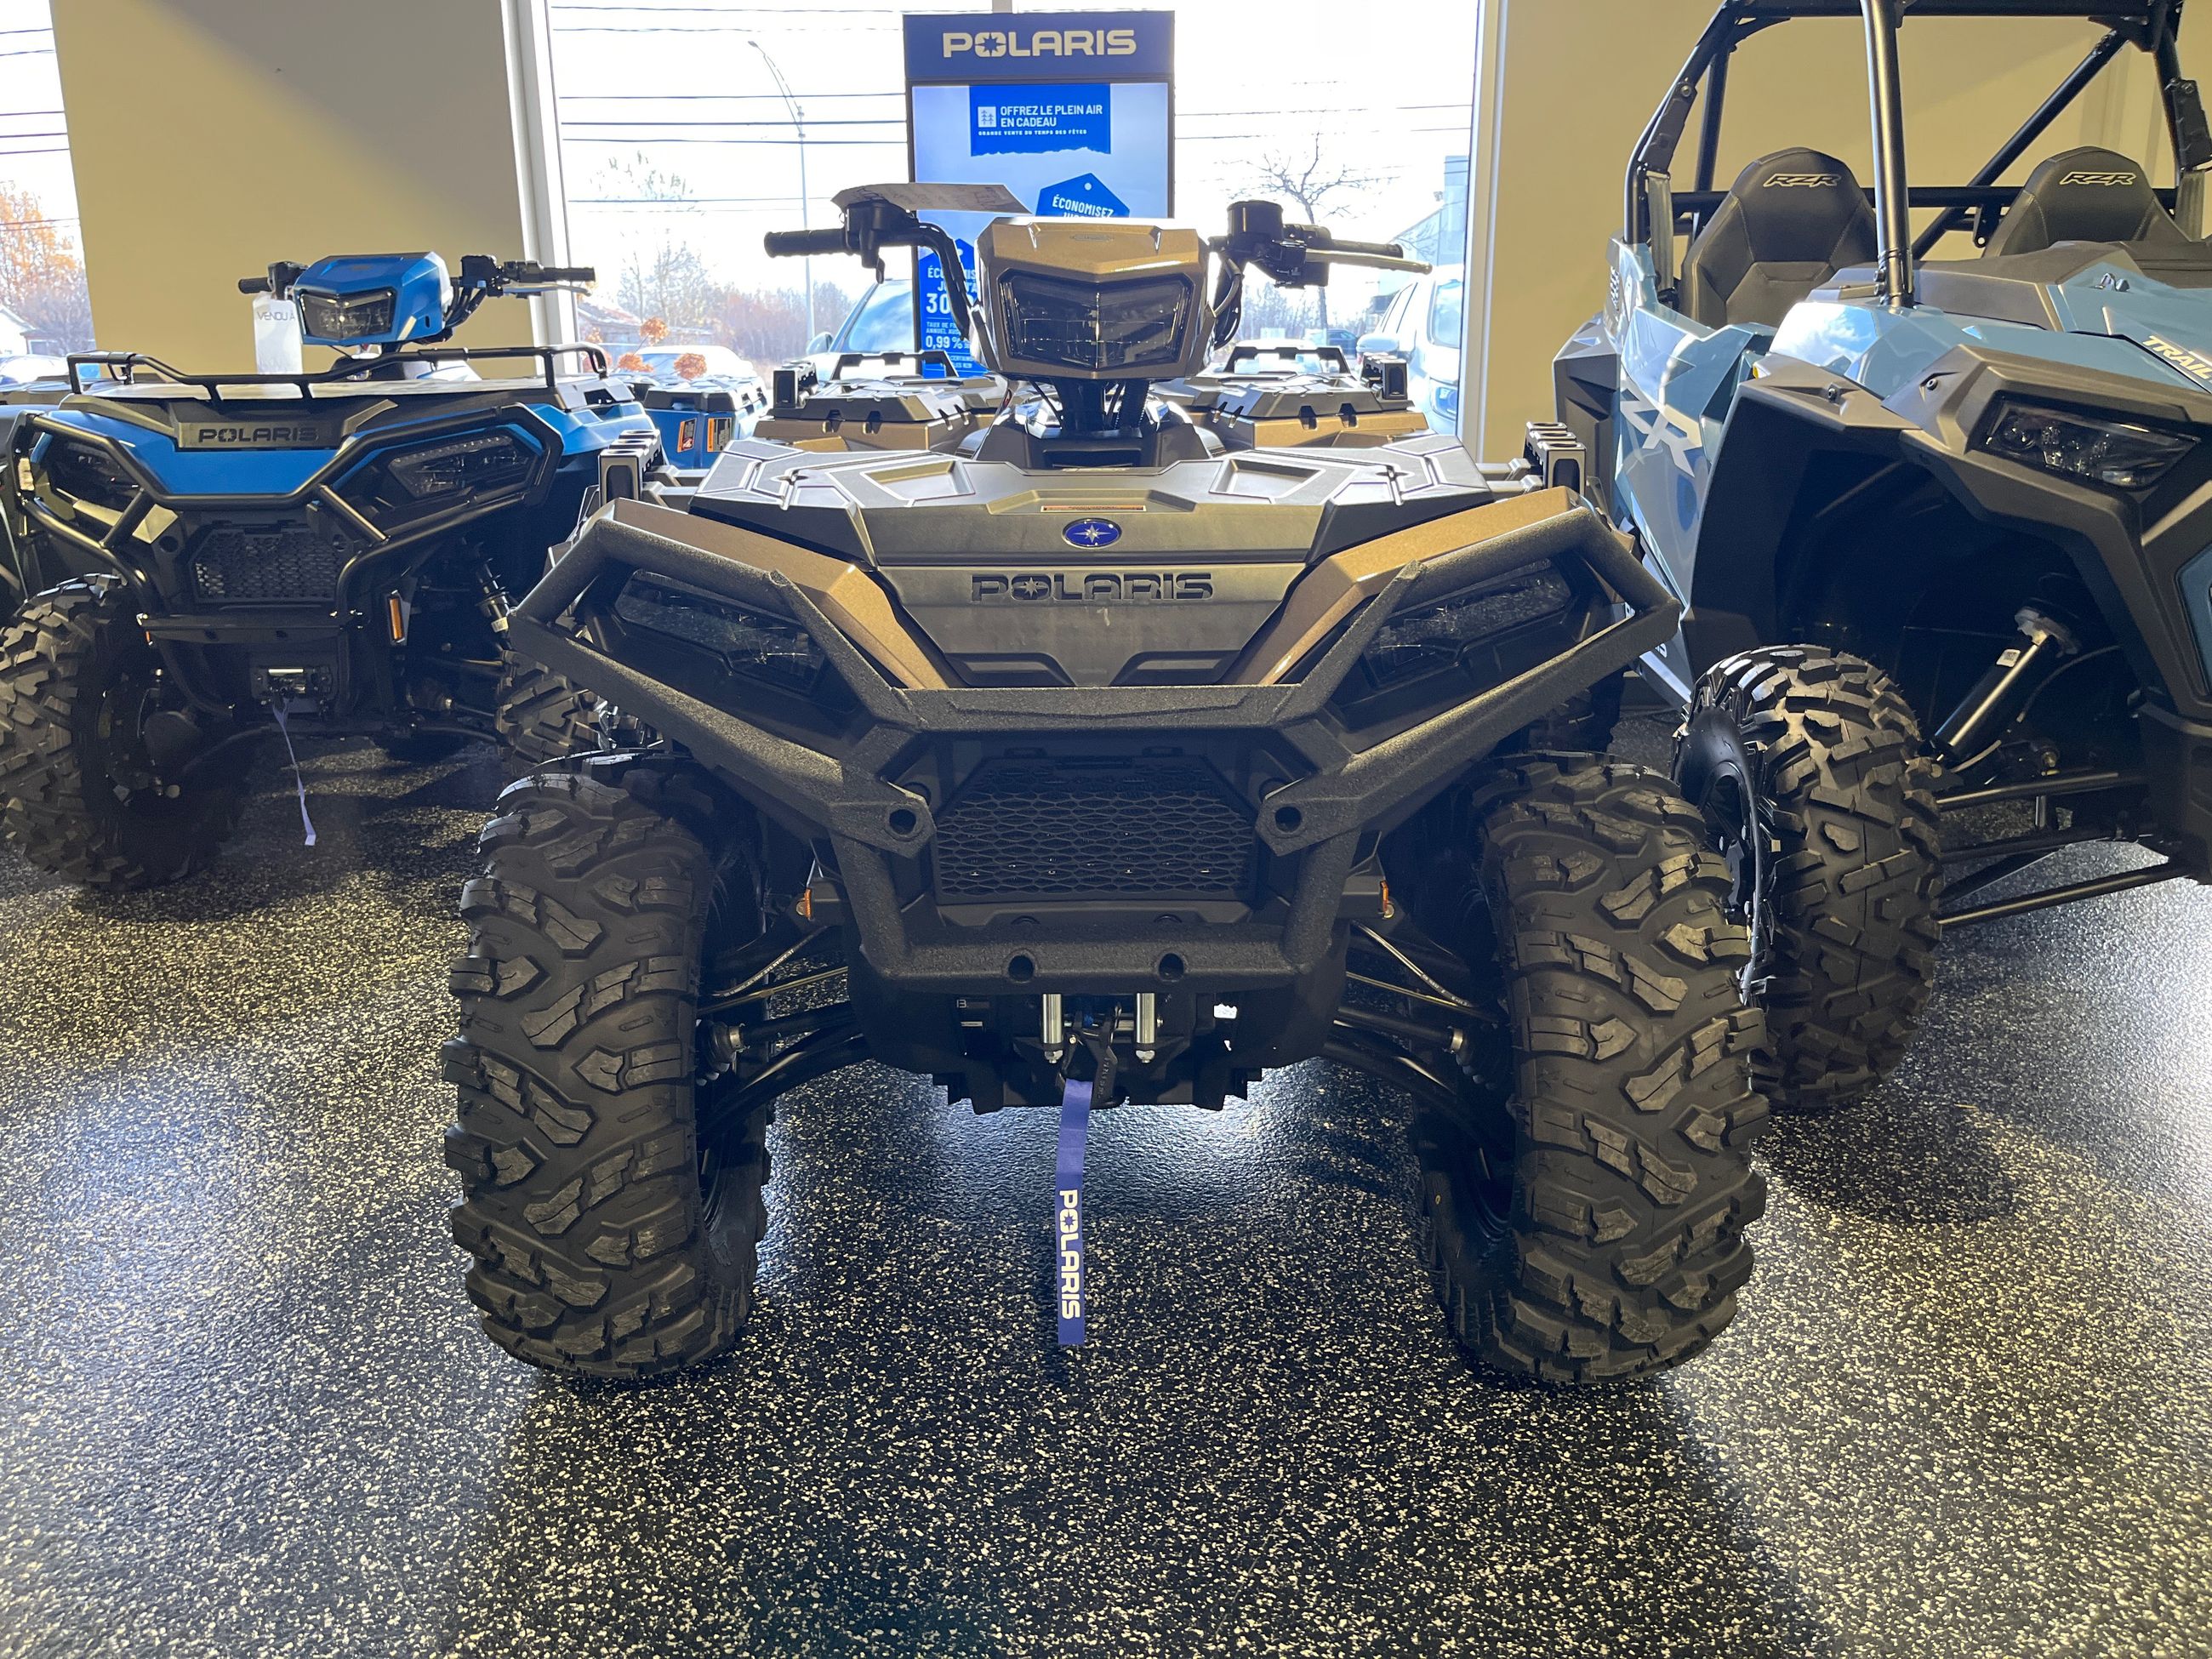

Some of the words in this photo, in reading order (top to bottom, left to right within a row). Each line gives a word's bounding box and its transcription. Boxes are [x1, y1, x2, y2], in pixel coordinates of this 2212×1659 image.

[943, 29, 1137, 58] POLARIS
[1001, 106, 1038, 116] OFFREZ
[1040, 105, 1053, 115] LE
[1055, 105, 1084, 115] PLEIN
[1086, 105, 1103, 114] AIR
[1001, 118, 1014, 128] EN
[1016, 117, 1057, 127] CADEAU
[1763, 173, 1842, 188] RZR
[2060, 171, 2137, 186] RZR
[1052, 194, 1115, 218] ÉCONOMISEZ
[926, 335, 950, 350] 0,99
[2142, 335, 2212, 379] TRAIL
[198, 427, 318, 443] POLARIS
[971, 572, 1214, 602] POLARIS
[1058, 1189, 1081, 1320] POLARIS
